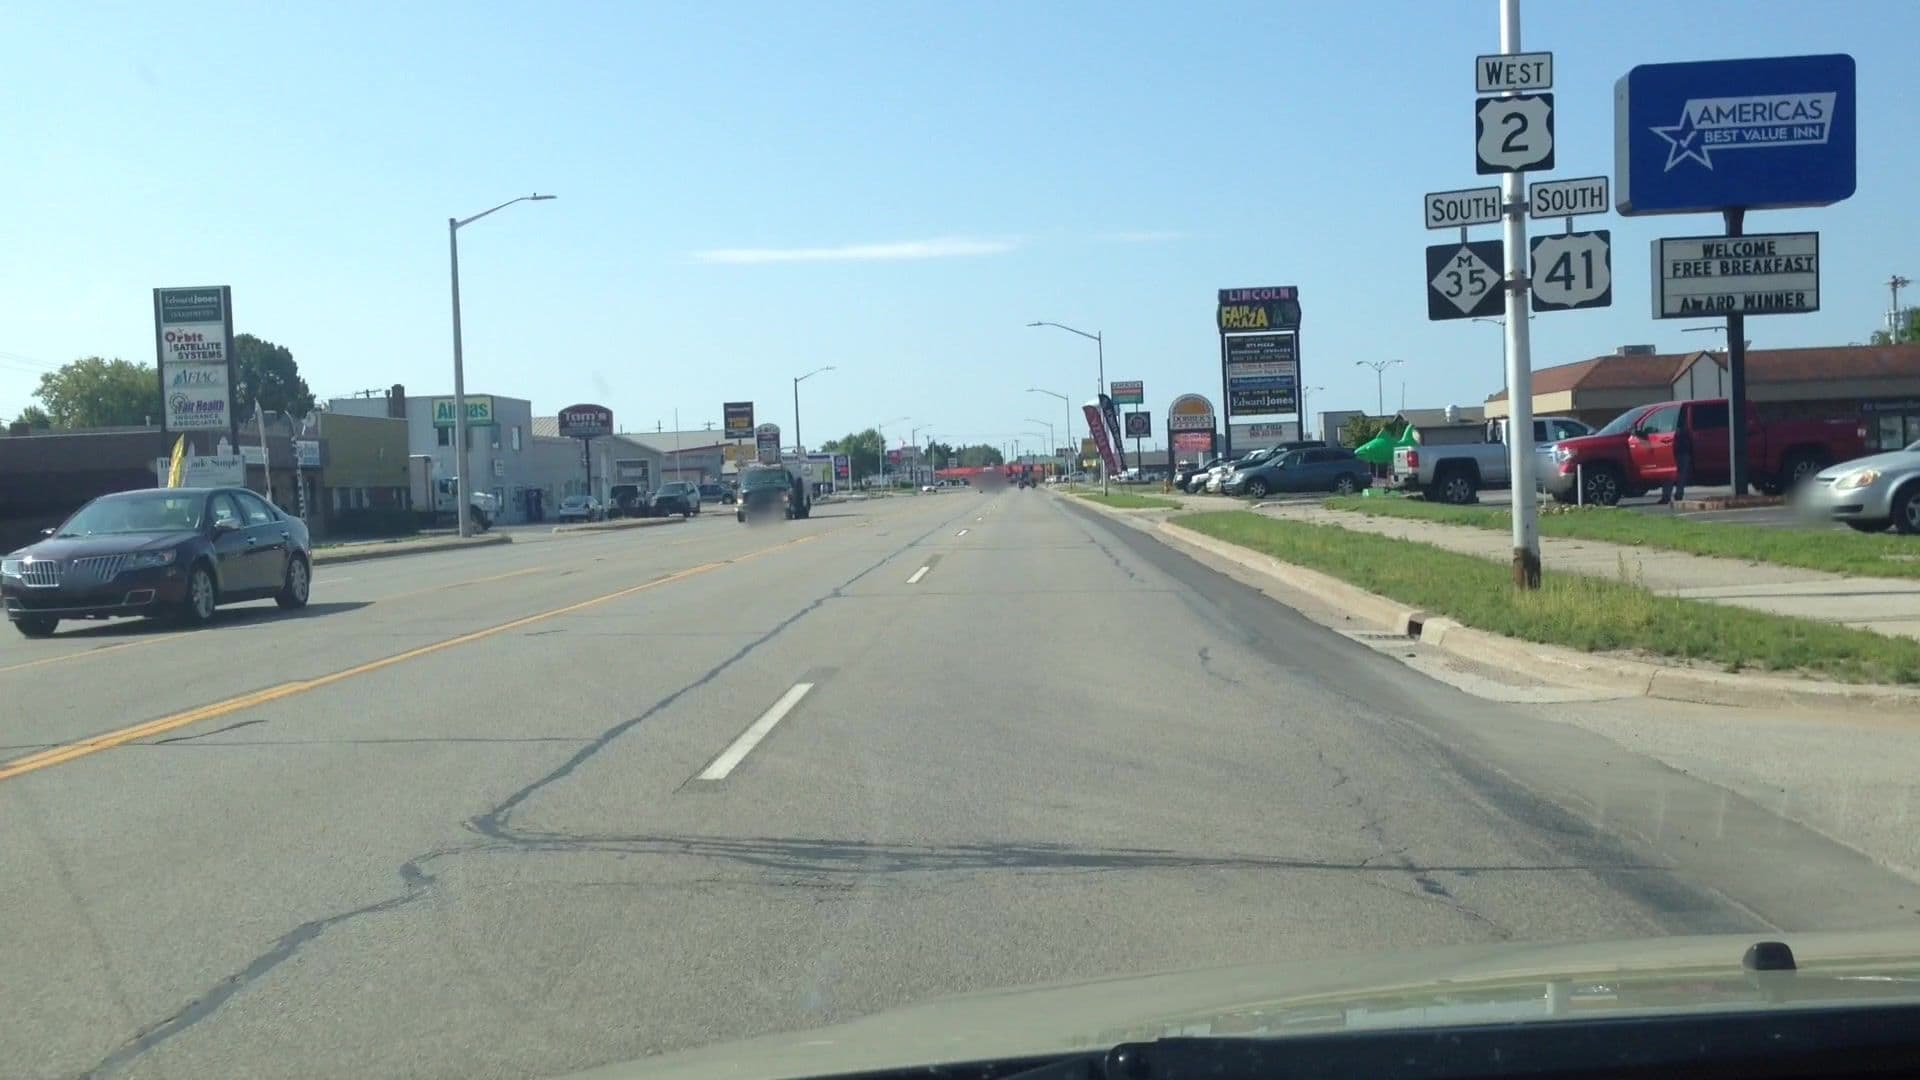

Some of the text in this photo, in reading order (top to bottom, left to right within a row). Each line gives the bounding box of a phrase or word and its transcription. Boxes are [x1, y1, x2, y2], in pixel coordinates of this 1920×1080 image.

[1486, 62, 1544, 86] WEST
[1697, 99, 1823, 125] AMERICAS
[1501, 111, 1529, 153] 2
[1704, 125, 1820, 143] BEST VALUE INN
[1536, 187, 1603, 212] SOUTH
[1432, 198, 1497, 222] SOUTH
[1702, 240, 1776, 259] WELCOME
[1457, 255, 1473, 268] M
[1545, 248, 1593, 291] 41
[1672, 256, 1814, 278] FREE BREAKFAST
[1446, 268, 1487, 298] 35
[1229, 288, 1289, 302] LINCOLN
[1680, 292, 1806, 313] AWARD WINNER
[165, 331, 203, 343] Orbit
[173, 341, 222, 351] SATELLITE
[177, 350, 222, 360] SYSTEMS
[196, 399, 225, 413] Health
[437, 401, 488, 420] Aias
[1232, 396, 1294, 407] Edward Jones
